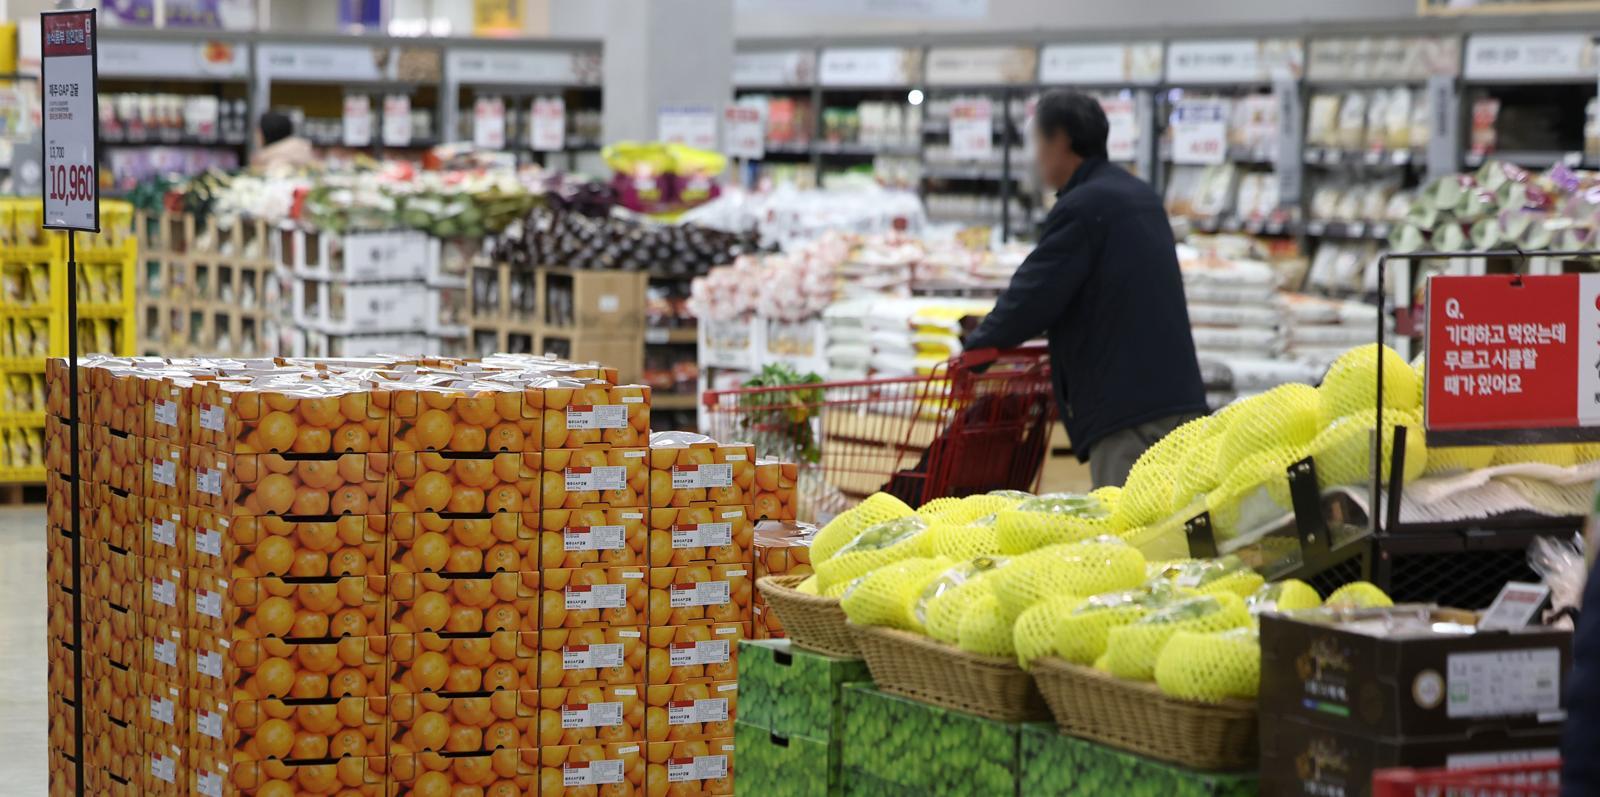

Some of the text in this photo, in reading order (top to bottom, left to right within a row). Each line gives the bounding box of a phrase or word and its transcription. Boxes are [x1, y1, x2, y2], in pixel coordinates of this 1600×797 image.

[49, 83, 79, 97] 제주 GAP 감귤
[49, 146, 65, 159] 13,700
[49, 164, 94, 207] 10,960
[1445, 297, 1464, 319] Q.
[1445, 322, 1566, 346] 기대하고 먹었는데
[1444, 348, 1538, 371] 무르고 시큼할
[1444, 374, 1522, 396] 때가 있어요
